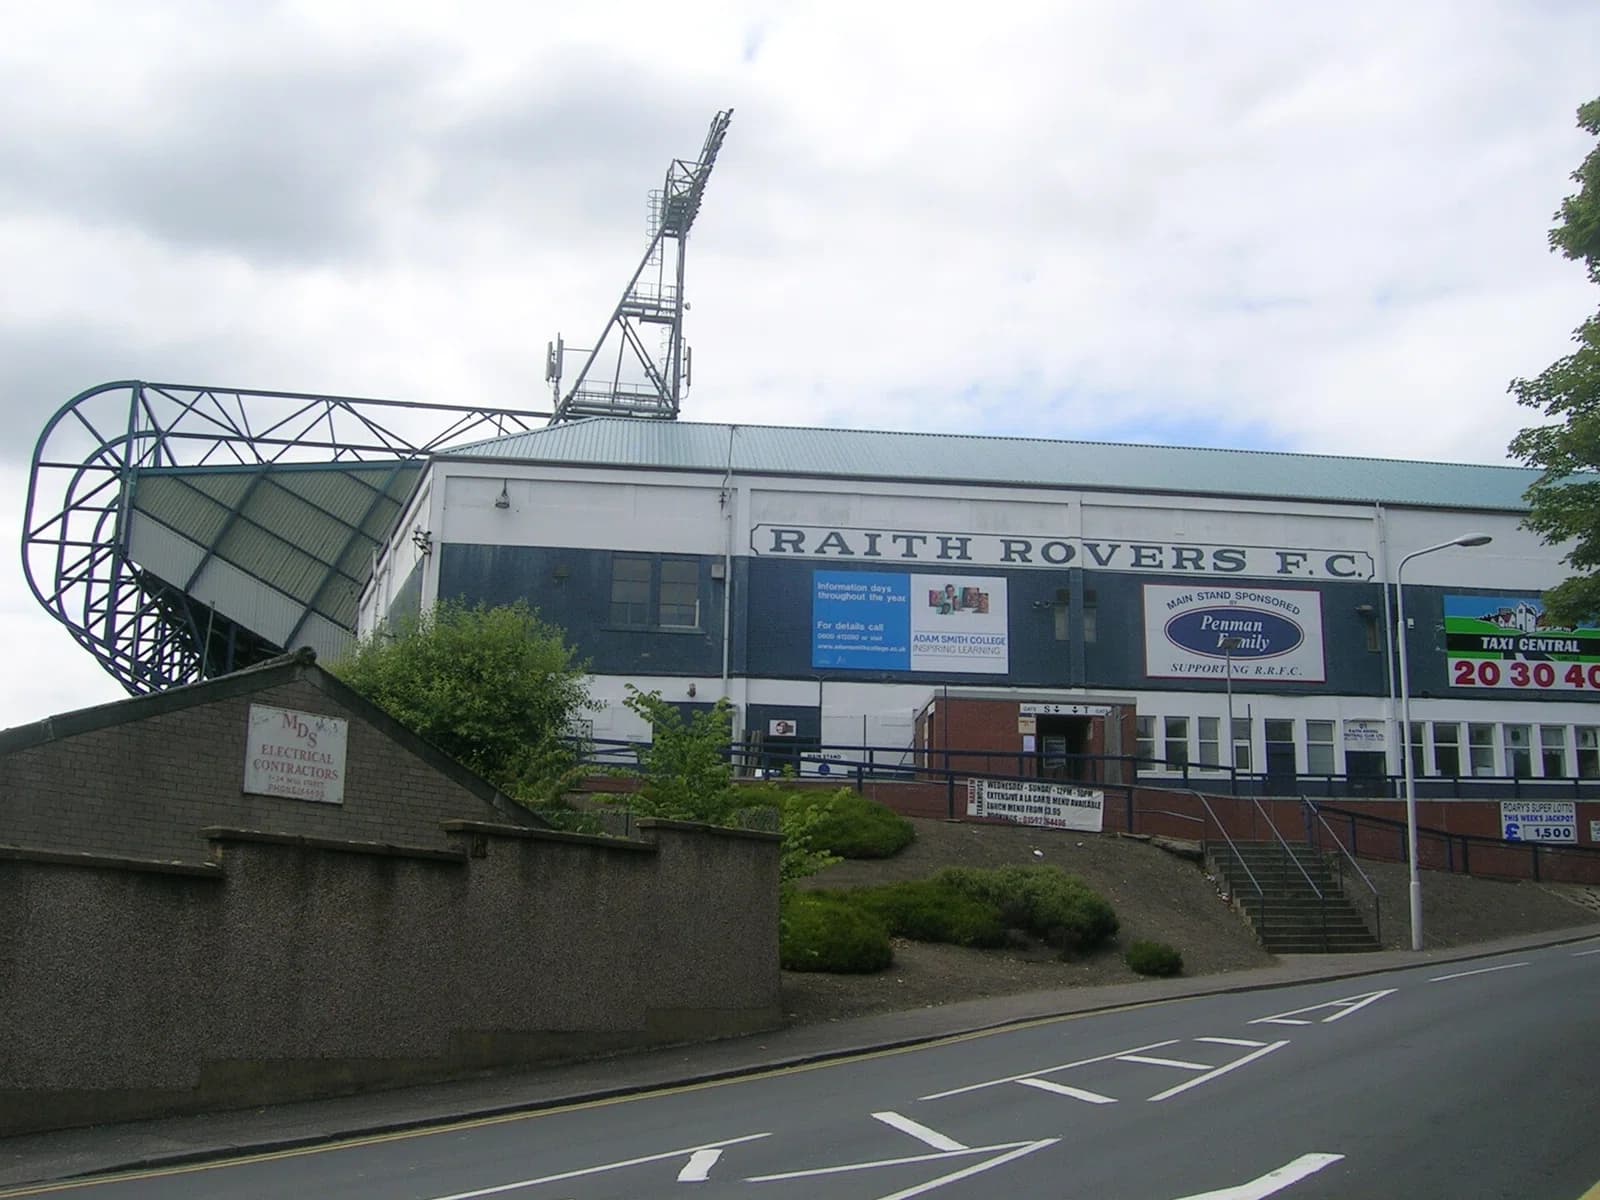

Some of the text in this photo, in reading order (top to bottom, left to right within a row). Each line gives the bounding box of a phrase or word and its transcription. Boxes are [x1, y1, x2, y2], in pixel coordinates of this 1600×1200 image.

[769, 529, 1363, 577] RAITH ROVERS F.C.
[817, 582, 892, 594] Information days
[817, 591, 906, 603] throughout the year
[1166, 591, 1301, 616] MAIN STAND SPONSORED
[817, 620, 885, 631] For details call
[1201, 615, 1263, 632] Penman
[913, 634, 1006, 646] ADAM SMITH COLLEGE
[1216, 633, 1270, 652] Fmily
[1480, 637, 1581, 653] TAXI CENTRAL
[913, 644, 1001, 655] INSPIRING LEARNING
[1171, 663, 1302, 676] SUPPORTNG R.R.F.C.
[1454, 660, 1501, 686] 20
[1510, 662, 1555, 688] 30
[281, 713, 318, 749] MDS
[261, 744, 335, 764] ELECTRICAL
[253, 759, 339, 779] CONTRACTORS
[987, 780, 1024, 791] WEDNESDAY
[1028, 783, 1051, 793] SUNDAY
[987, 791, 1018, 802] EXTENSIVE
[1052, 796, 1070, 806] MENU
[1070, 799, 1101, 809] AVAILABLE
[1007, 803, 1025, 813] MENU
[1026, 805, 1043, 814] FROM
[1531, 803, 1552, 813] SUPER
[1553, 803, 1573, 813] LOTTO
[1503, 814, 1519, 822] THIS
[1544, 814, 1574, 822] JACKPOT
[1534, 827, 1571, 839] 1,500
